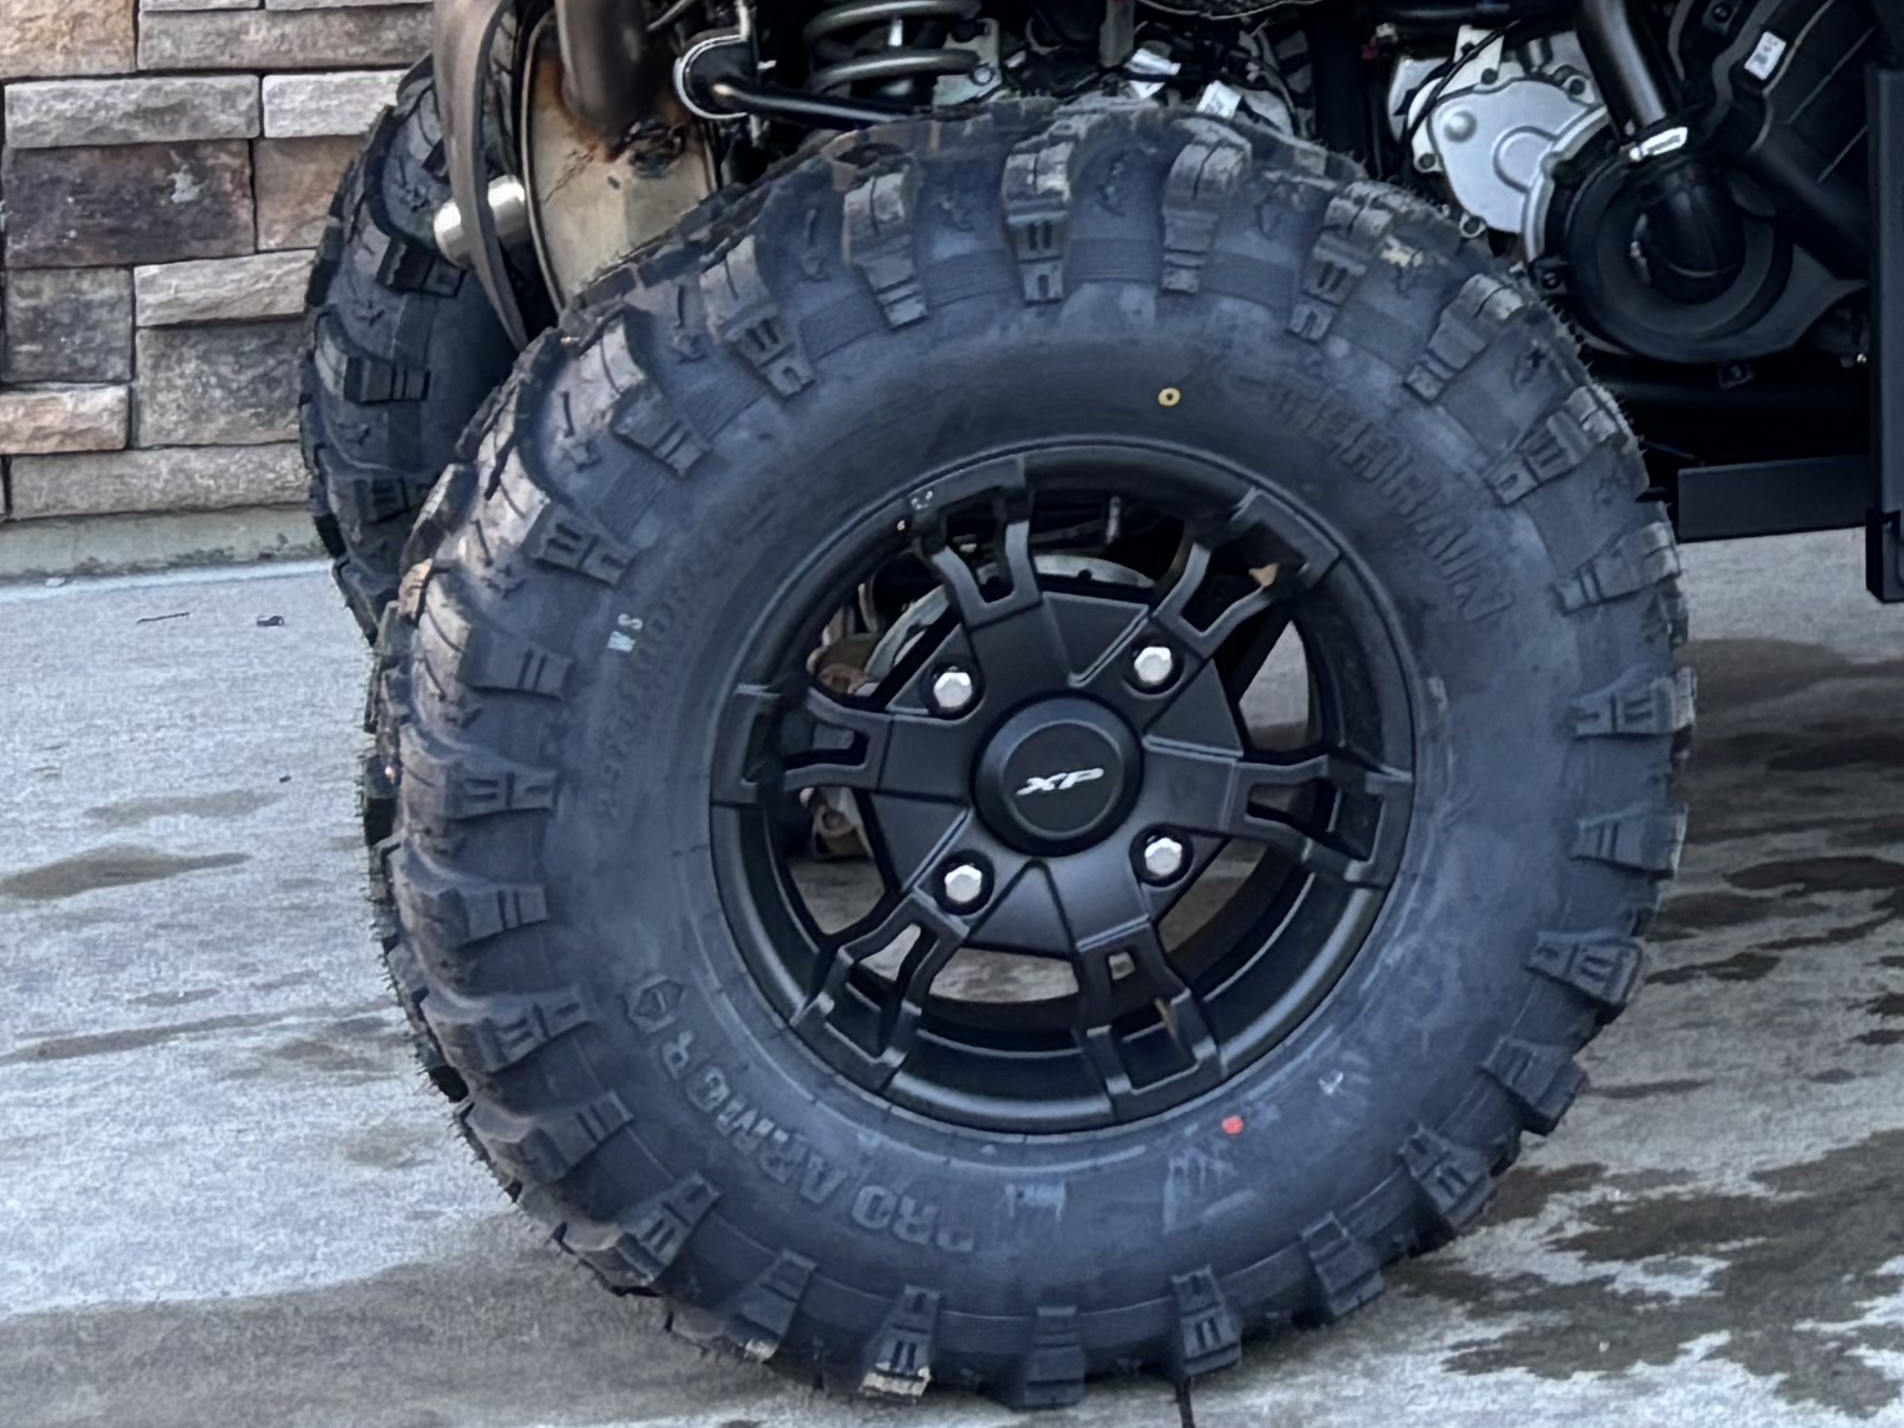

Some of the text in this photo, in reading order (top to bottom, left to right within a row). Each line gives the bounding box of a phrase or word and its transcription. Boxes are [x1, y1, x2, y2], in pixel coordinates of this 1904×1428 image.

[1015, 767, 1104, 796] XP
[661, 1029, 976, 1254] PRO ARMOR
